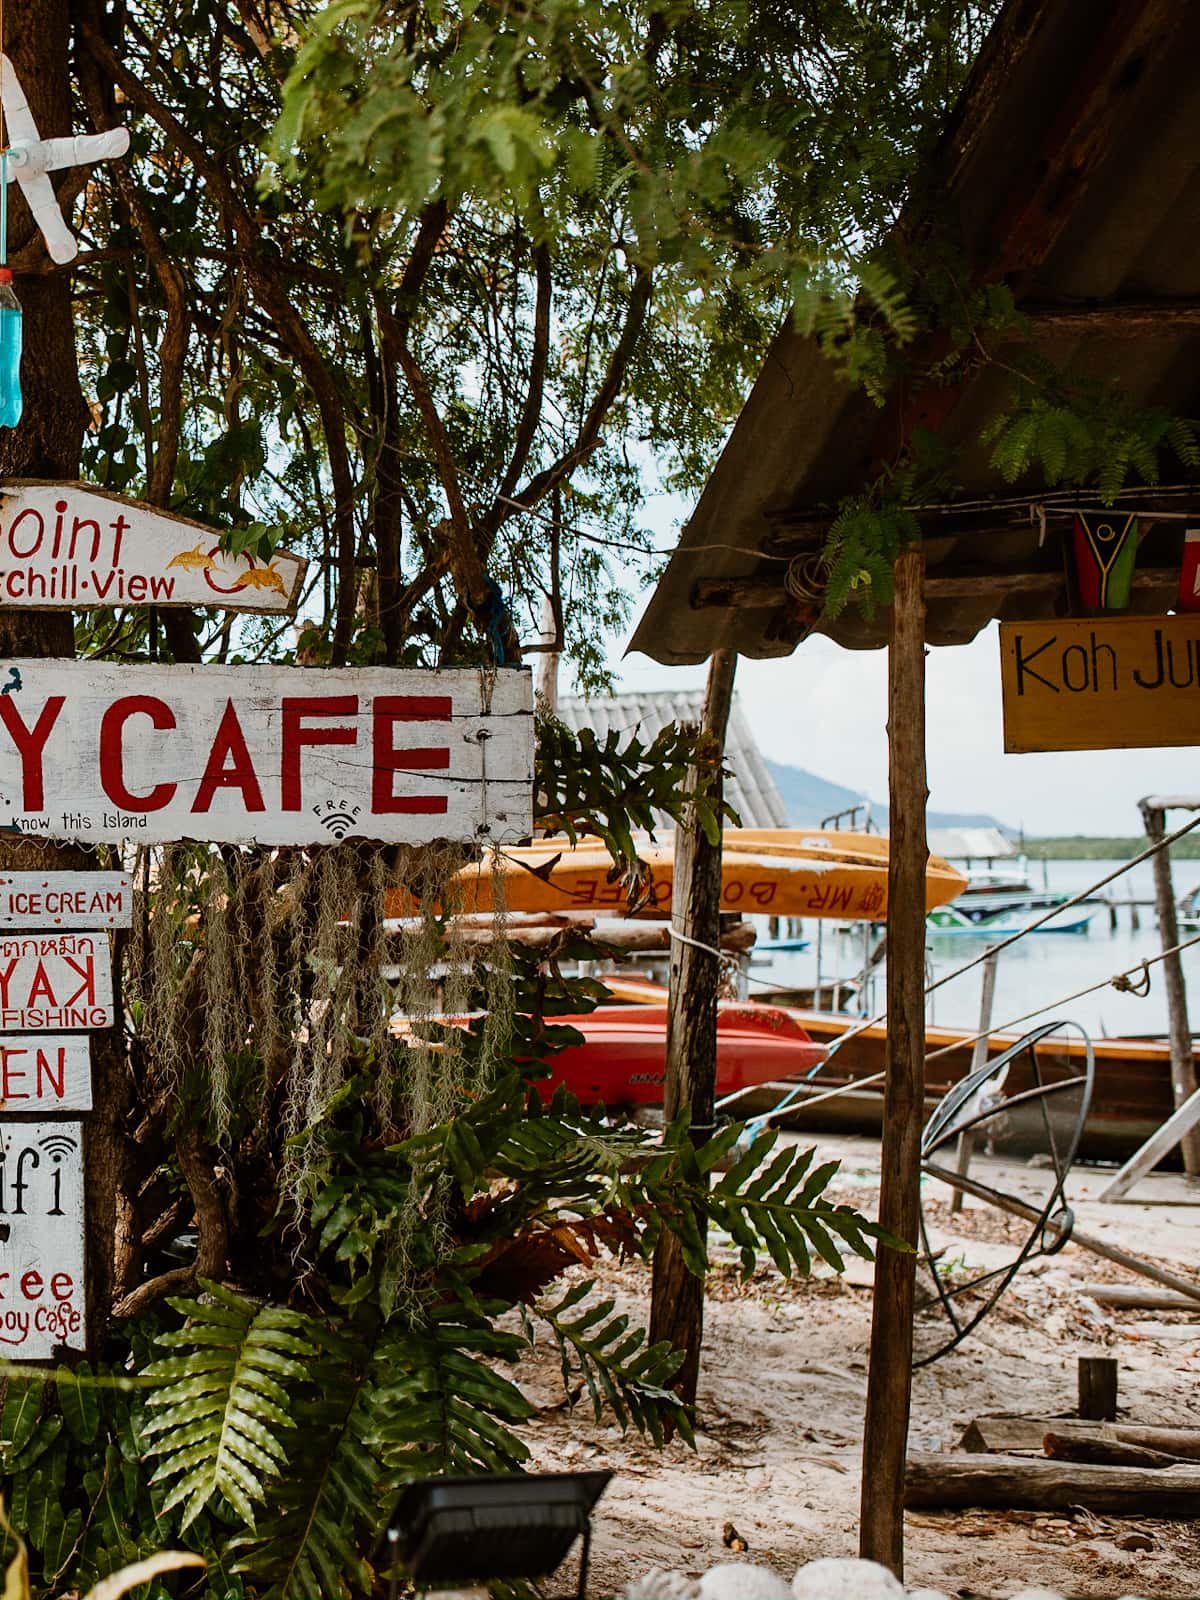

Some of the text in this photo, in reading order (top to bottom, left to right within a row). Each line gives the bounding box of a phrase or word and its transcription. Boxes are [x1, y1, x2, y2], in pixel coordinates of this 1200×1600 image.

[1014, 631, 1118, 696] Koh
[99, 694, 453, 815] CAFE
[62, 812, 92, 830] this
[102, 810, 148, 829] Island
[312, 799, 362, 816] FREE
[800, 884, 855, 912] MR.
[3, 935, 95, 958] ตกหมึก
[2, 1007, 107, 1029] FISHING
[34, 1302, 81, 1340] Cafe
